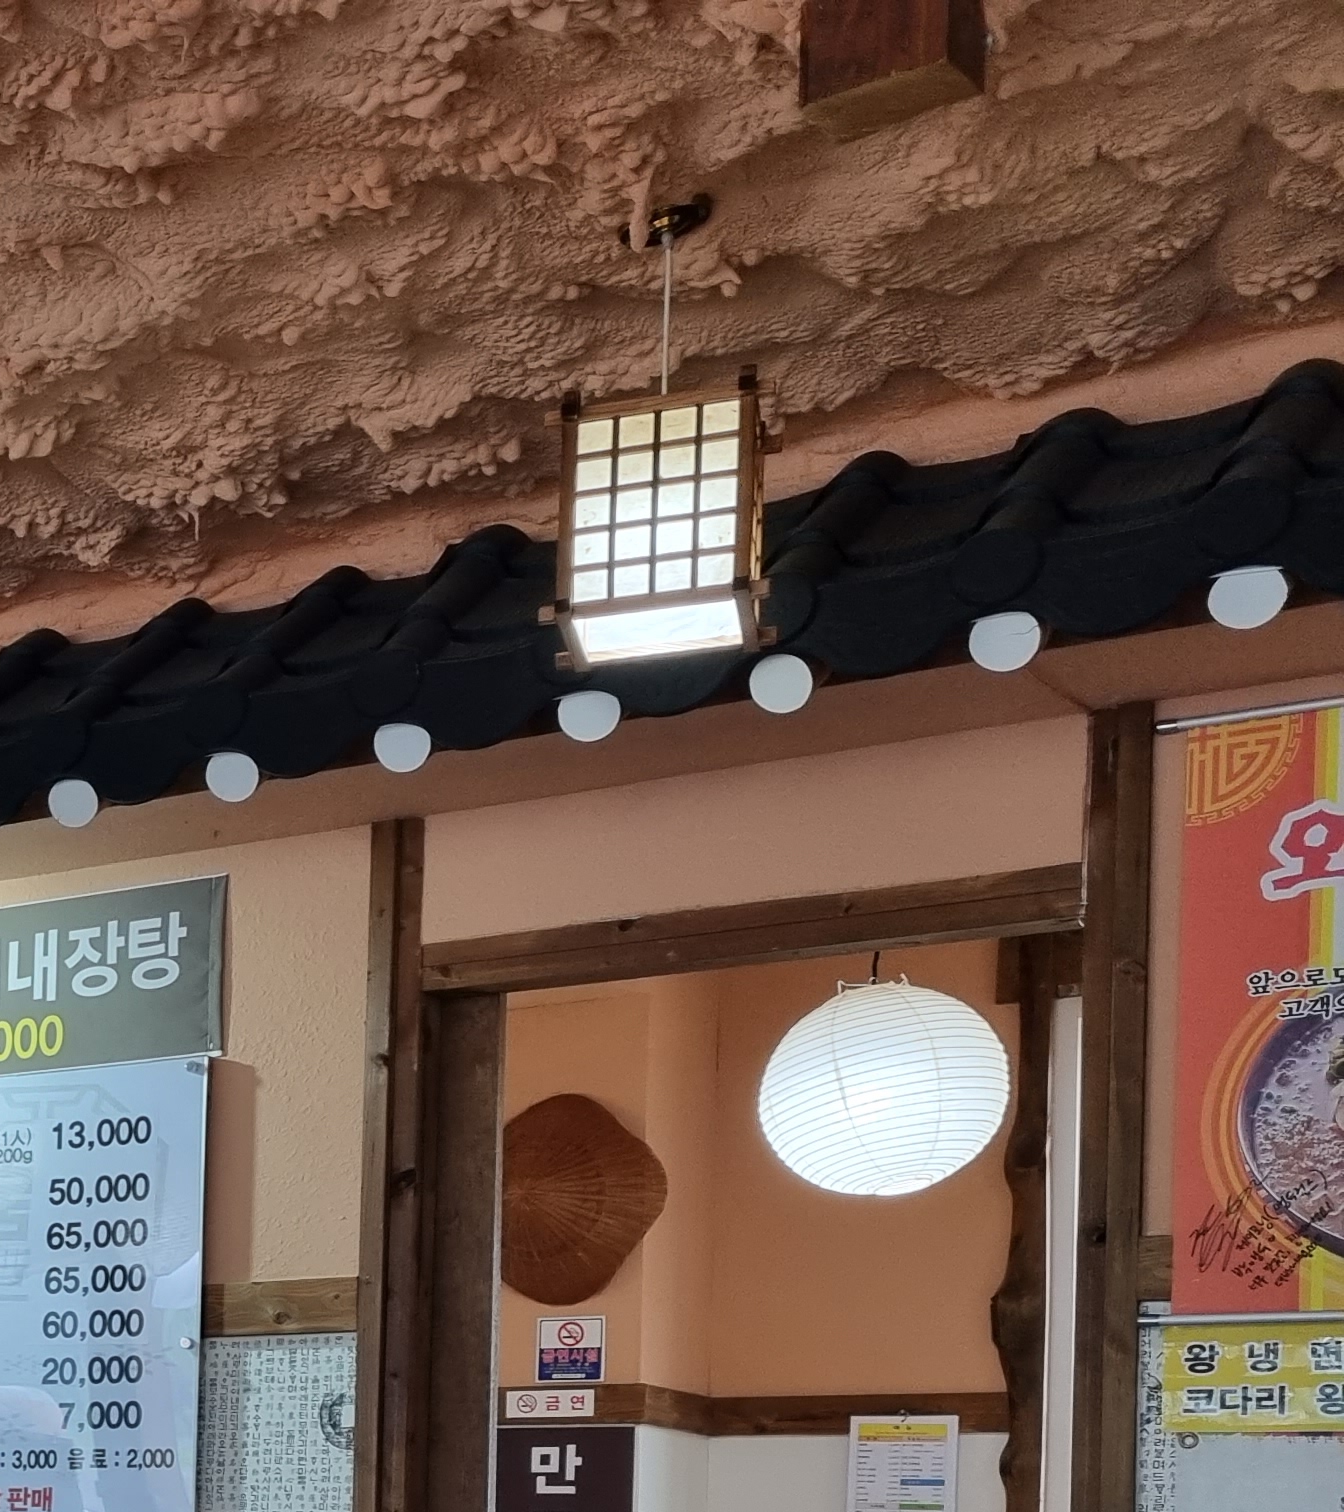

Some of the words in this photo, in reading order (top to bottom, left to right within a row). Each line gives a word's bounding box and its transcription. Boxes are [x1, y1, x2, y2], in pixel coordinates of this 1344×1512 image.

[52, 1116, 152, 1151] 13,000
[49, 1172, 150, 1207] 50,000
[47, 1218, 148, 1252] 65,000
[44, 1264, 146, 1297] 65,000
[42, 1309, 144, 1342] 60,000
[42, 1355, 143, 1388] 20,000
[59, 1400, 143, 1433] 7,000
[1183, 1385, 1286, 1415] 코다리
[12, 1449, 57, 1471] 3,000
[127, 1448, 175, 1470] 2,000
[7, 1486, 53, 1512] 판매
